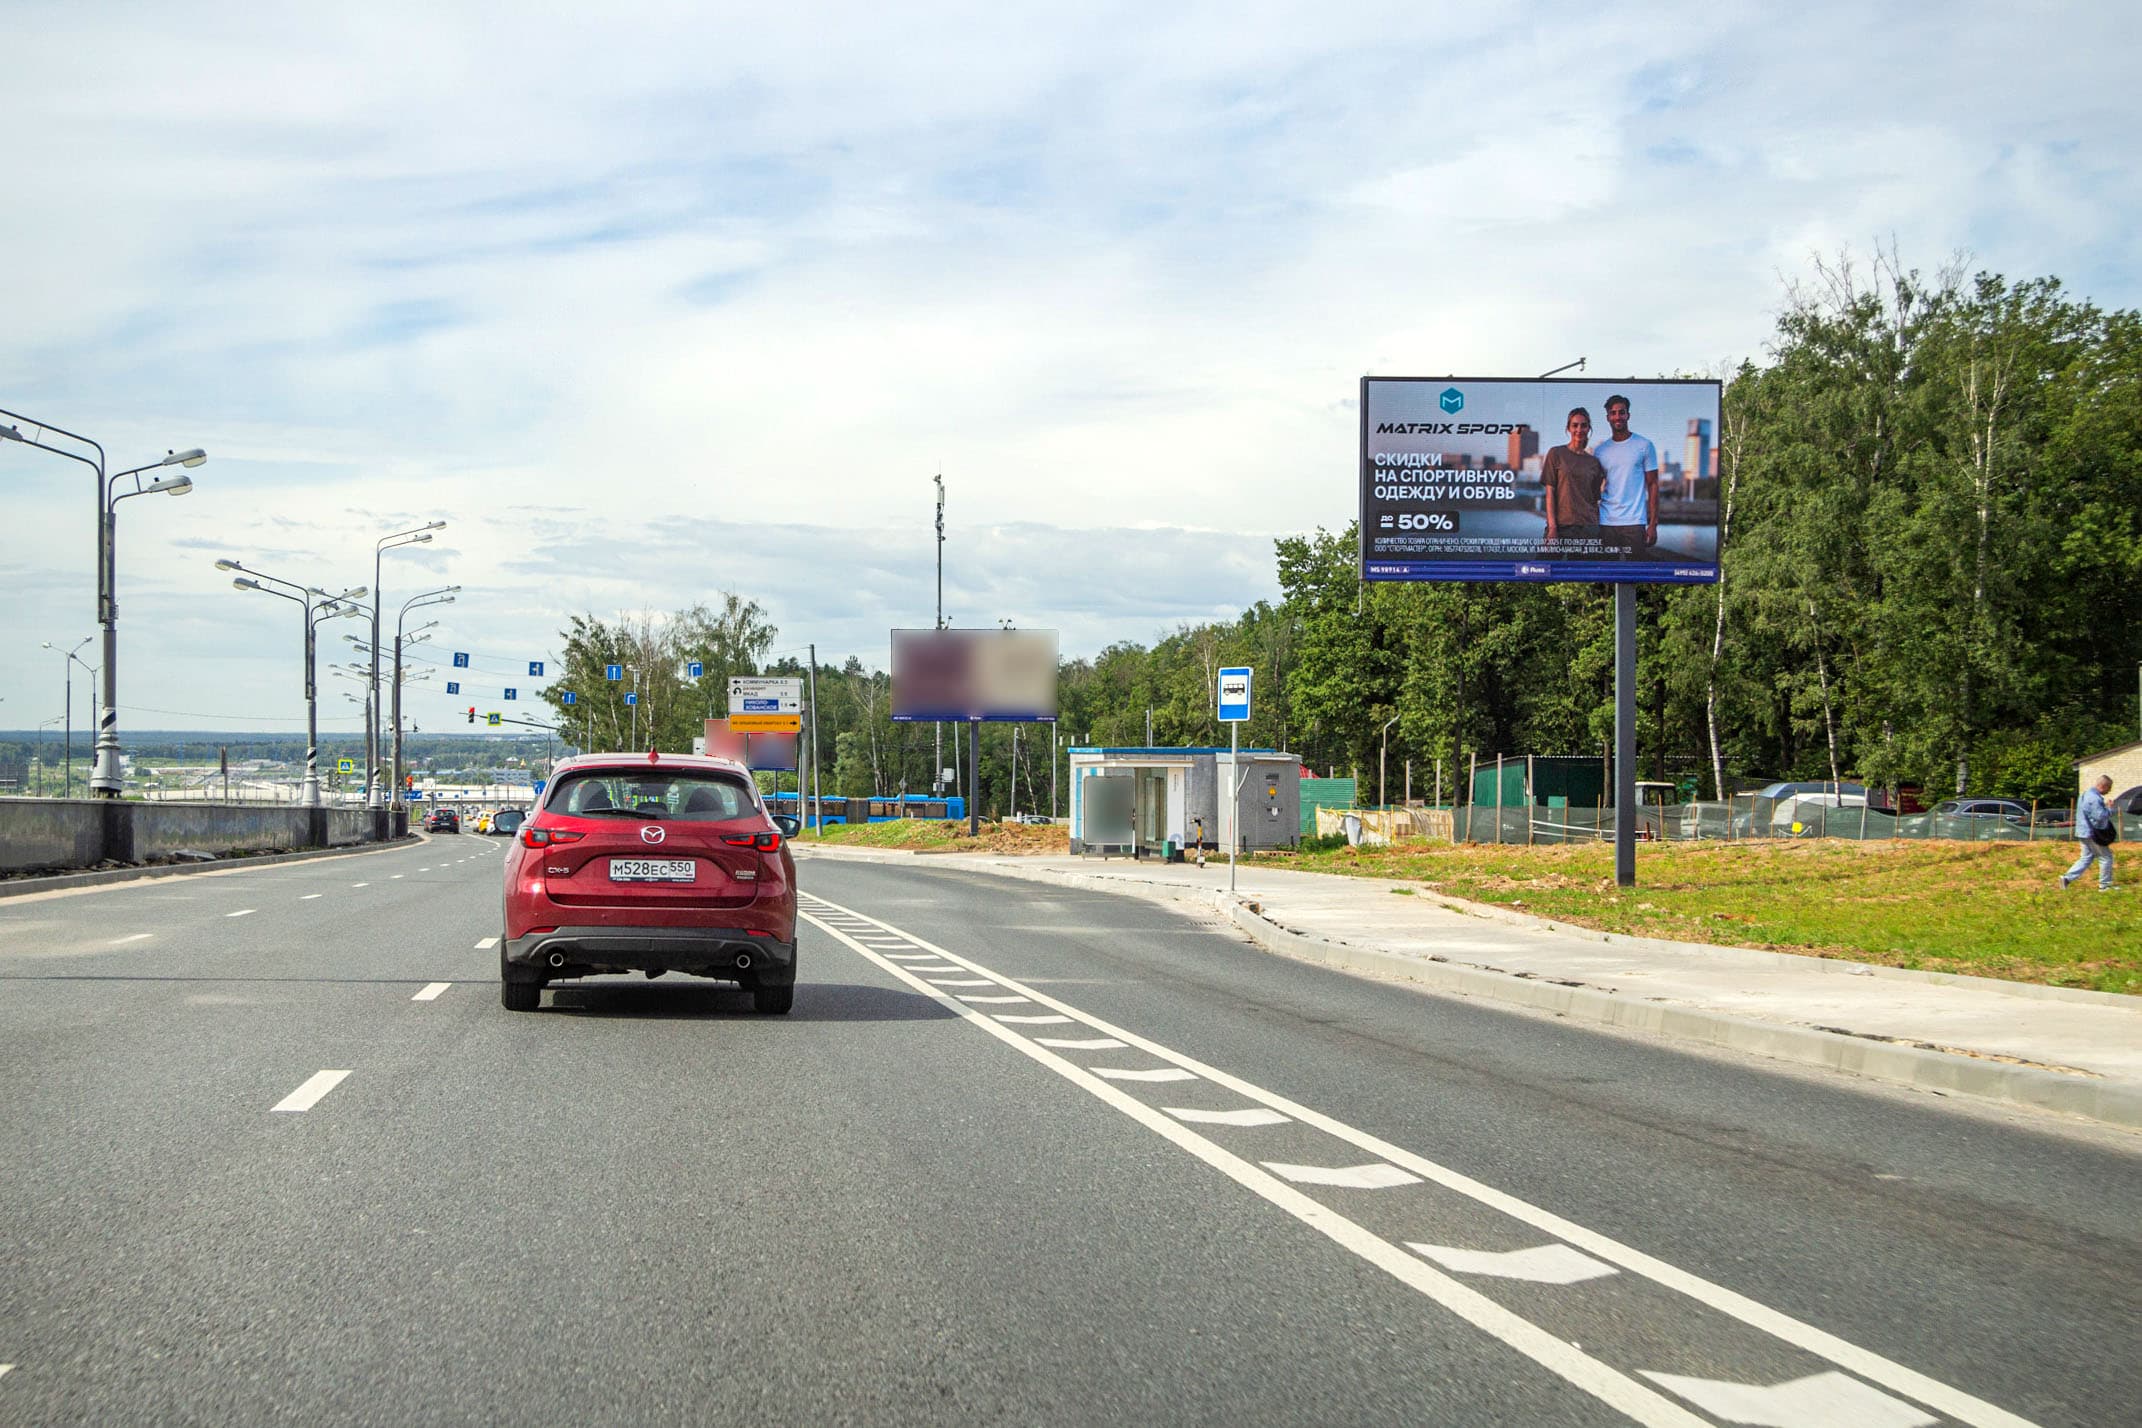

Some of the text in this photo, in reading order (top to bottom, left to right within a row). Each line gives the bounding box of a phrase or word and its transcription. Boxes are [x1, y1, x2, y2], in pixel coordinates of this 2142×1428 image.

[1376, 423, 1530, 435] MATRIX SPORT
[1374, 453, 1442, 468] СКИДКИ
[1374, 469, 1515, 483] НА СПОРТИВНУЮ
[1374, 486, 1516, 501] ОДЕЖДУ И ОБУВЬ
[670, 862, 691, 872] 550
